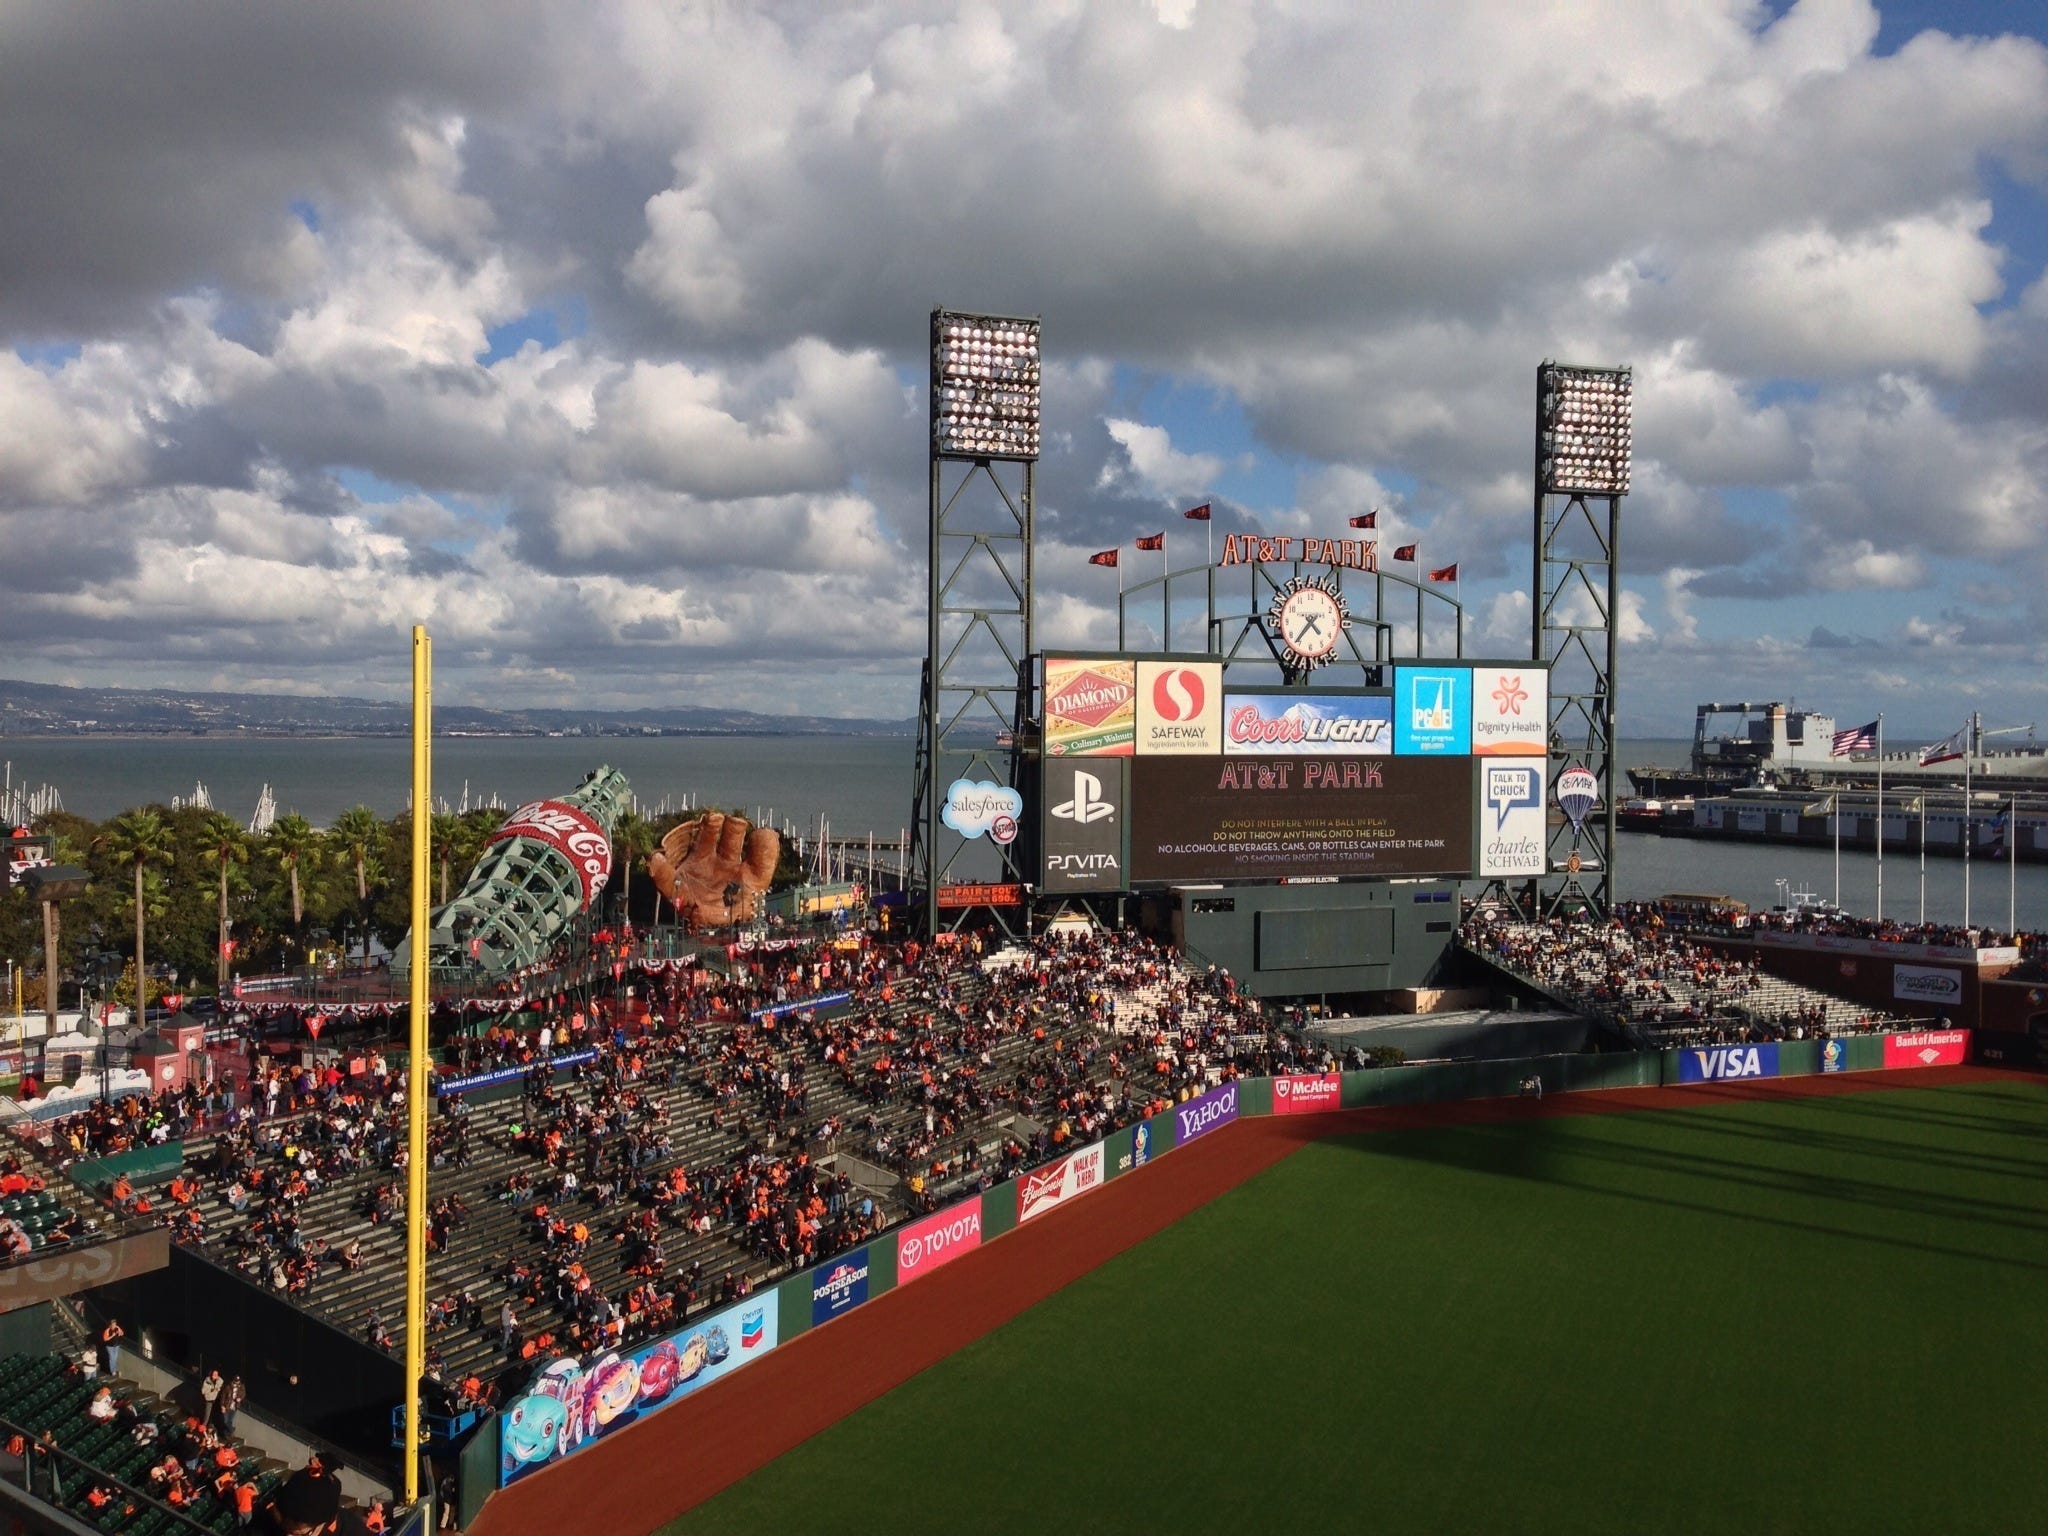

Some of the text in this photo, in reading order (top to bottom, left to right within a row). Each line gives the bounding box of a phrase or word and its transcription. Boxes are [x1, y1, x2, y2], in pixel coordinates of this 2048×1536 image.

[1221, 534, 1378, 574] AT&T PARK
[1269, 575, 1353, 630] SAN FRANCISCO
[1306, 592, 1315, 601] 12
[1288, 605, 1296, 614] 10
[1281, 645, 1340, 671] GIANTS
[1053, 684, 1128, 716] DIAMOND
[1151, 727, 1205, 739] SAFEWAY
[1229, 704, 1387, 744] Coors LIGHT
[1478, 719, 1542, 735] Dignity Health
[1071, 731, 1133, 750] Culinary Walnuts
[1218, 761, 1384, 790] AT&T PARK
[1494, 774, 1527, 783] TALK TO
[1561, 775, 1593, 791] RE/MAX
[1493, 784, 1526, 796] CHUCK
[951, 794, 1014, 820] salesforce
[1221, 821, 1235, 829] DO
[1237, 820, 1255, 828] NOT
[1257, 819, 1302, 828] INTERFERE
[1304, 819, 1325, 827] WITH
[1335, 818, 1355, 826] BALL
[1357, 818, 1365, 826] IN
[1367, 818, 1388, 826] PLAY
[1213, 829, 1396, 841] DO NOT THROW ANYTHING ONTO THE FIELD
[1158, 845, 1173, 854] NO
[1174, 843, 1227, 853] ALCOHOLIC
[1229, 842, 1280, 852] BEVERAGES,
[1308, 841, 1320, 850] OR
[1322, 841, 1359, 850] BOTTLES
[1360, 840, 1378, 849] CAN
[1380, 840, 1405, 849] ENTER
[1407, 840, 1423, 848] THE
[1424, 839, 1446, 848] PARK
[1487, 836, 1539, 855] charles
[1235, 852, 1375, 863] NO SMOKING INSIDE THE STADIUM
[1487, 856, 1540, 868] SCHWAB
[1896, 1031, 1963, 1048] Bank of America
[1694, 1047, 1761, 1079] VISA
[446, 1078, 467, 1090] WORLD
[467, 1072, 494, 1086] BASEBALL
[494, 1067, 516, 1079] CLASSIC
[1292, 1080, 1338, 1094] McAfee
[1179, 1087, 1236, 1139] YAHOO!
[1073, 1155, 1089, 1174] WALK
[1081, 1168, 1096, 1187] HERO
[1021, 1176, 1064, 1205] Budweiser
[924, 1213, 980, 1255] TOYOTA
[813, 1265, 868, 1302] POSTSEASON
